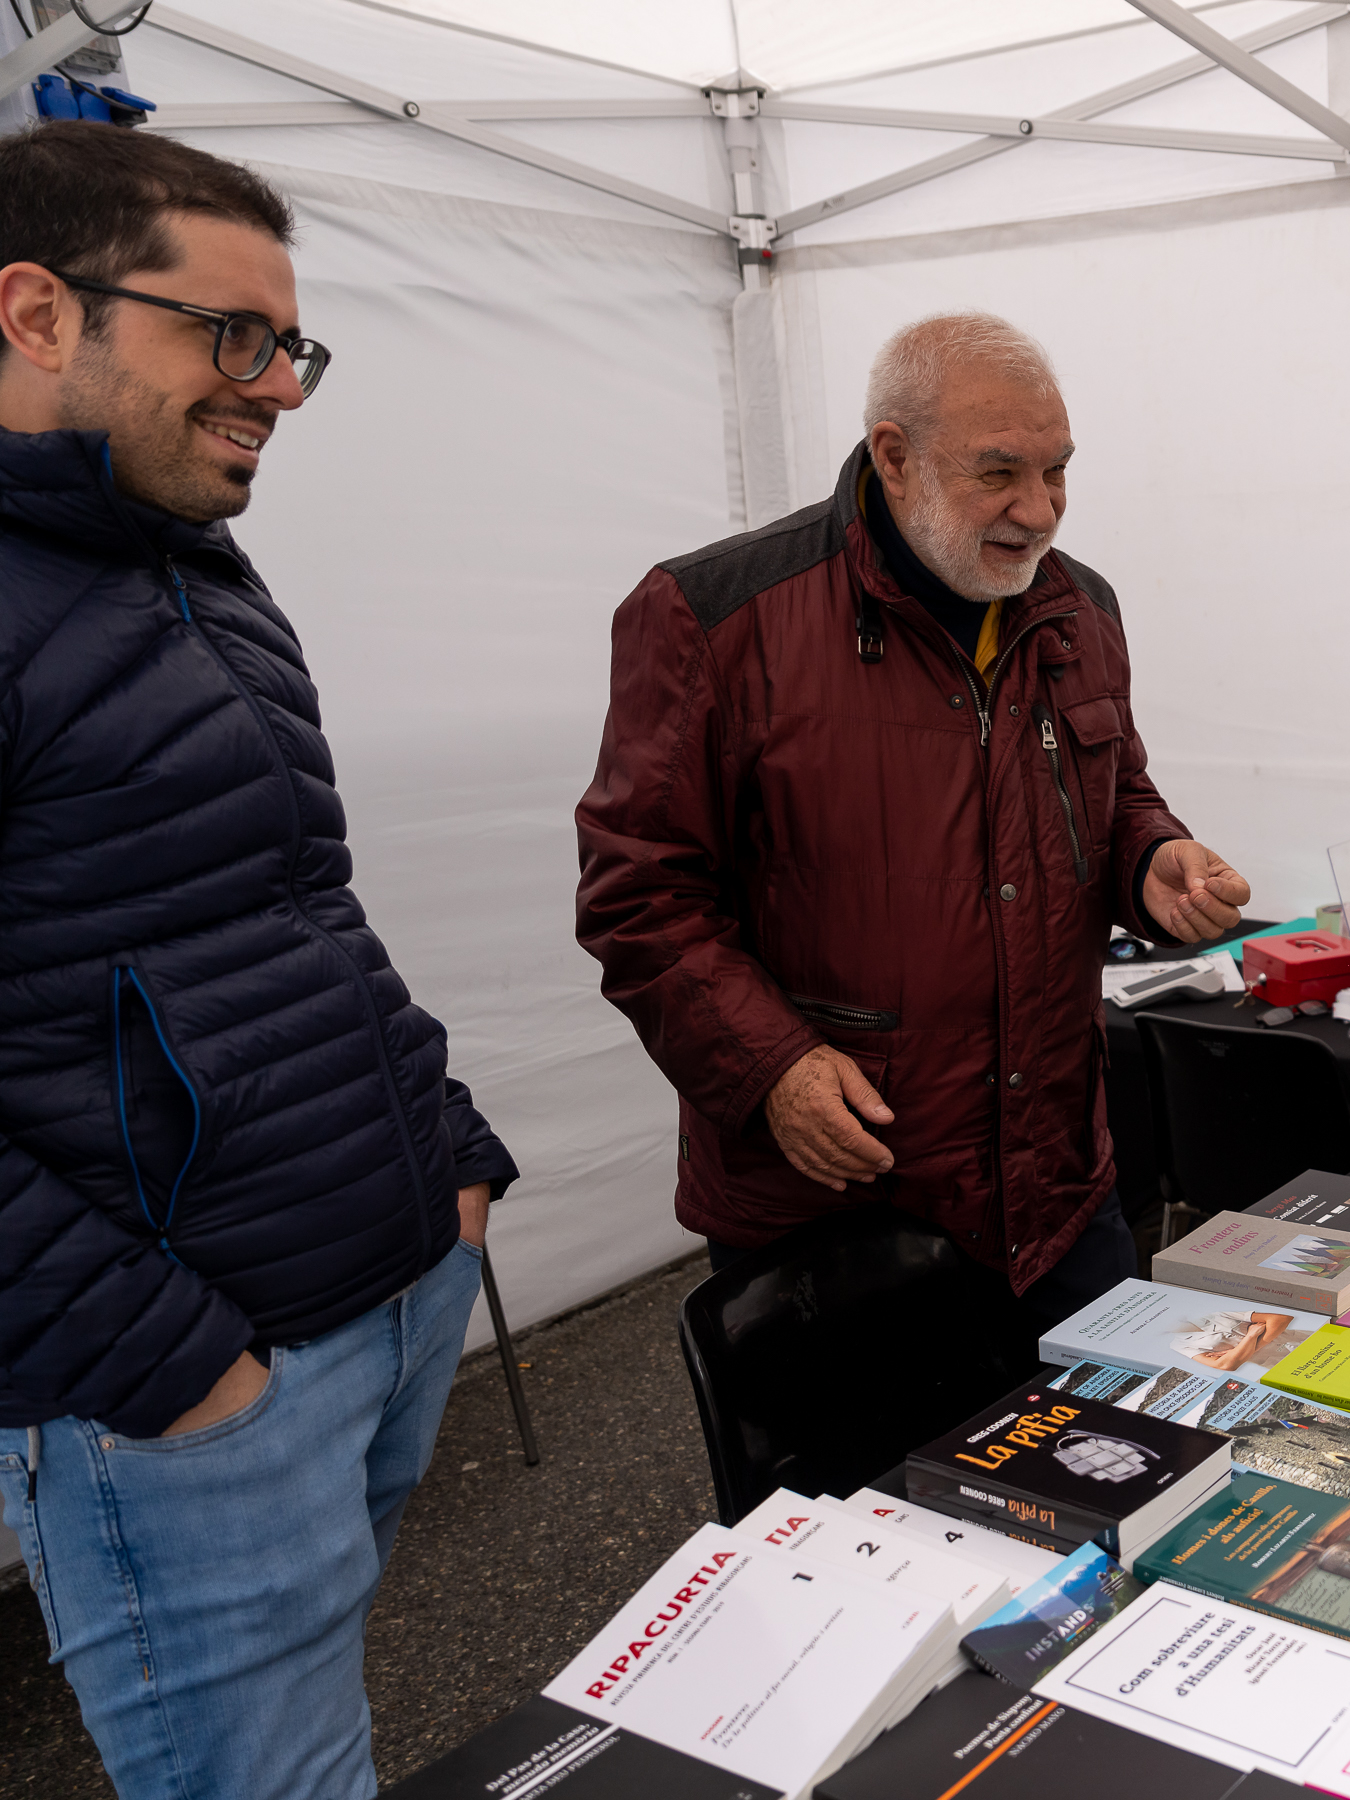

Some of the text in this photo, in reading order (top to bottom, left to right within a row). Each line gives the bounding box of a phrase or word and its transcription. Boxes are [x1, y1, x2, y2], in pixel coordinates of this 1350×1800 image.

[1189, 1222, 1242, 1254] Frontera
[1222, 1230, 1259, 1256] endins
[1291, 1369, 1300, 1377] El
[966, 1412, 1019, 1443] GREG COONEN
[955, 1444, 1018, 1471] La
[959, 1484, 987, 1501] COONEN
[988, 1493, 1006, 1508] GREG
[944, 1530, 965, 1544] 4
[1039, 1509, 1055, 1531] La
[1171, 1484, 1278, 1566] Homes i dones de Canillo,
[856, 1541, 882, 1558] 2
[792, 1572, 815, 1582] 1
[585, 1551, 738, 1699] RIPACURTIA
[610, 1555, 753, 1707] REVISTA PIRINENCA DEL CENTRE D'ESTUDIS RIBAGORÇANS
[1178, 1660, 1189, 1669] a
[1188, 1638, 1214, 1660] una
[1210, 1617, 1236, 1639] tesi
[1119, 1667, 1153, 1695] Com
[1151, 1610, 1216, 1667] sobreviure
[1175, 1624, 1256, 1697] d'Humanitats
[953, 1695, 1032, 1760] Poemes de Sispony
[983, 1699, 1045, 1749] Poeta confinat
[1007, 1707, 1066, 1758] NACHO MAYO
[485, 1774, 510, 1792] Del
[507, 1760, 532, 1777] Pas
[530, 1748, 548, 1764] de
[543, 1740, 560, 1754] la
[557, 1723, 590, 1744] Casa,
[502, 1760, 550, 1794] menuda
[549, 1726, 600, 1762] memòria
